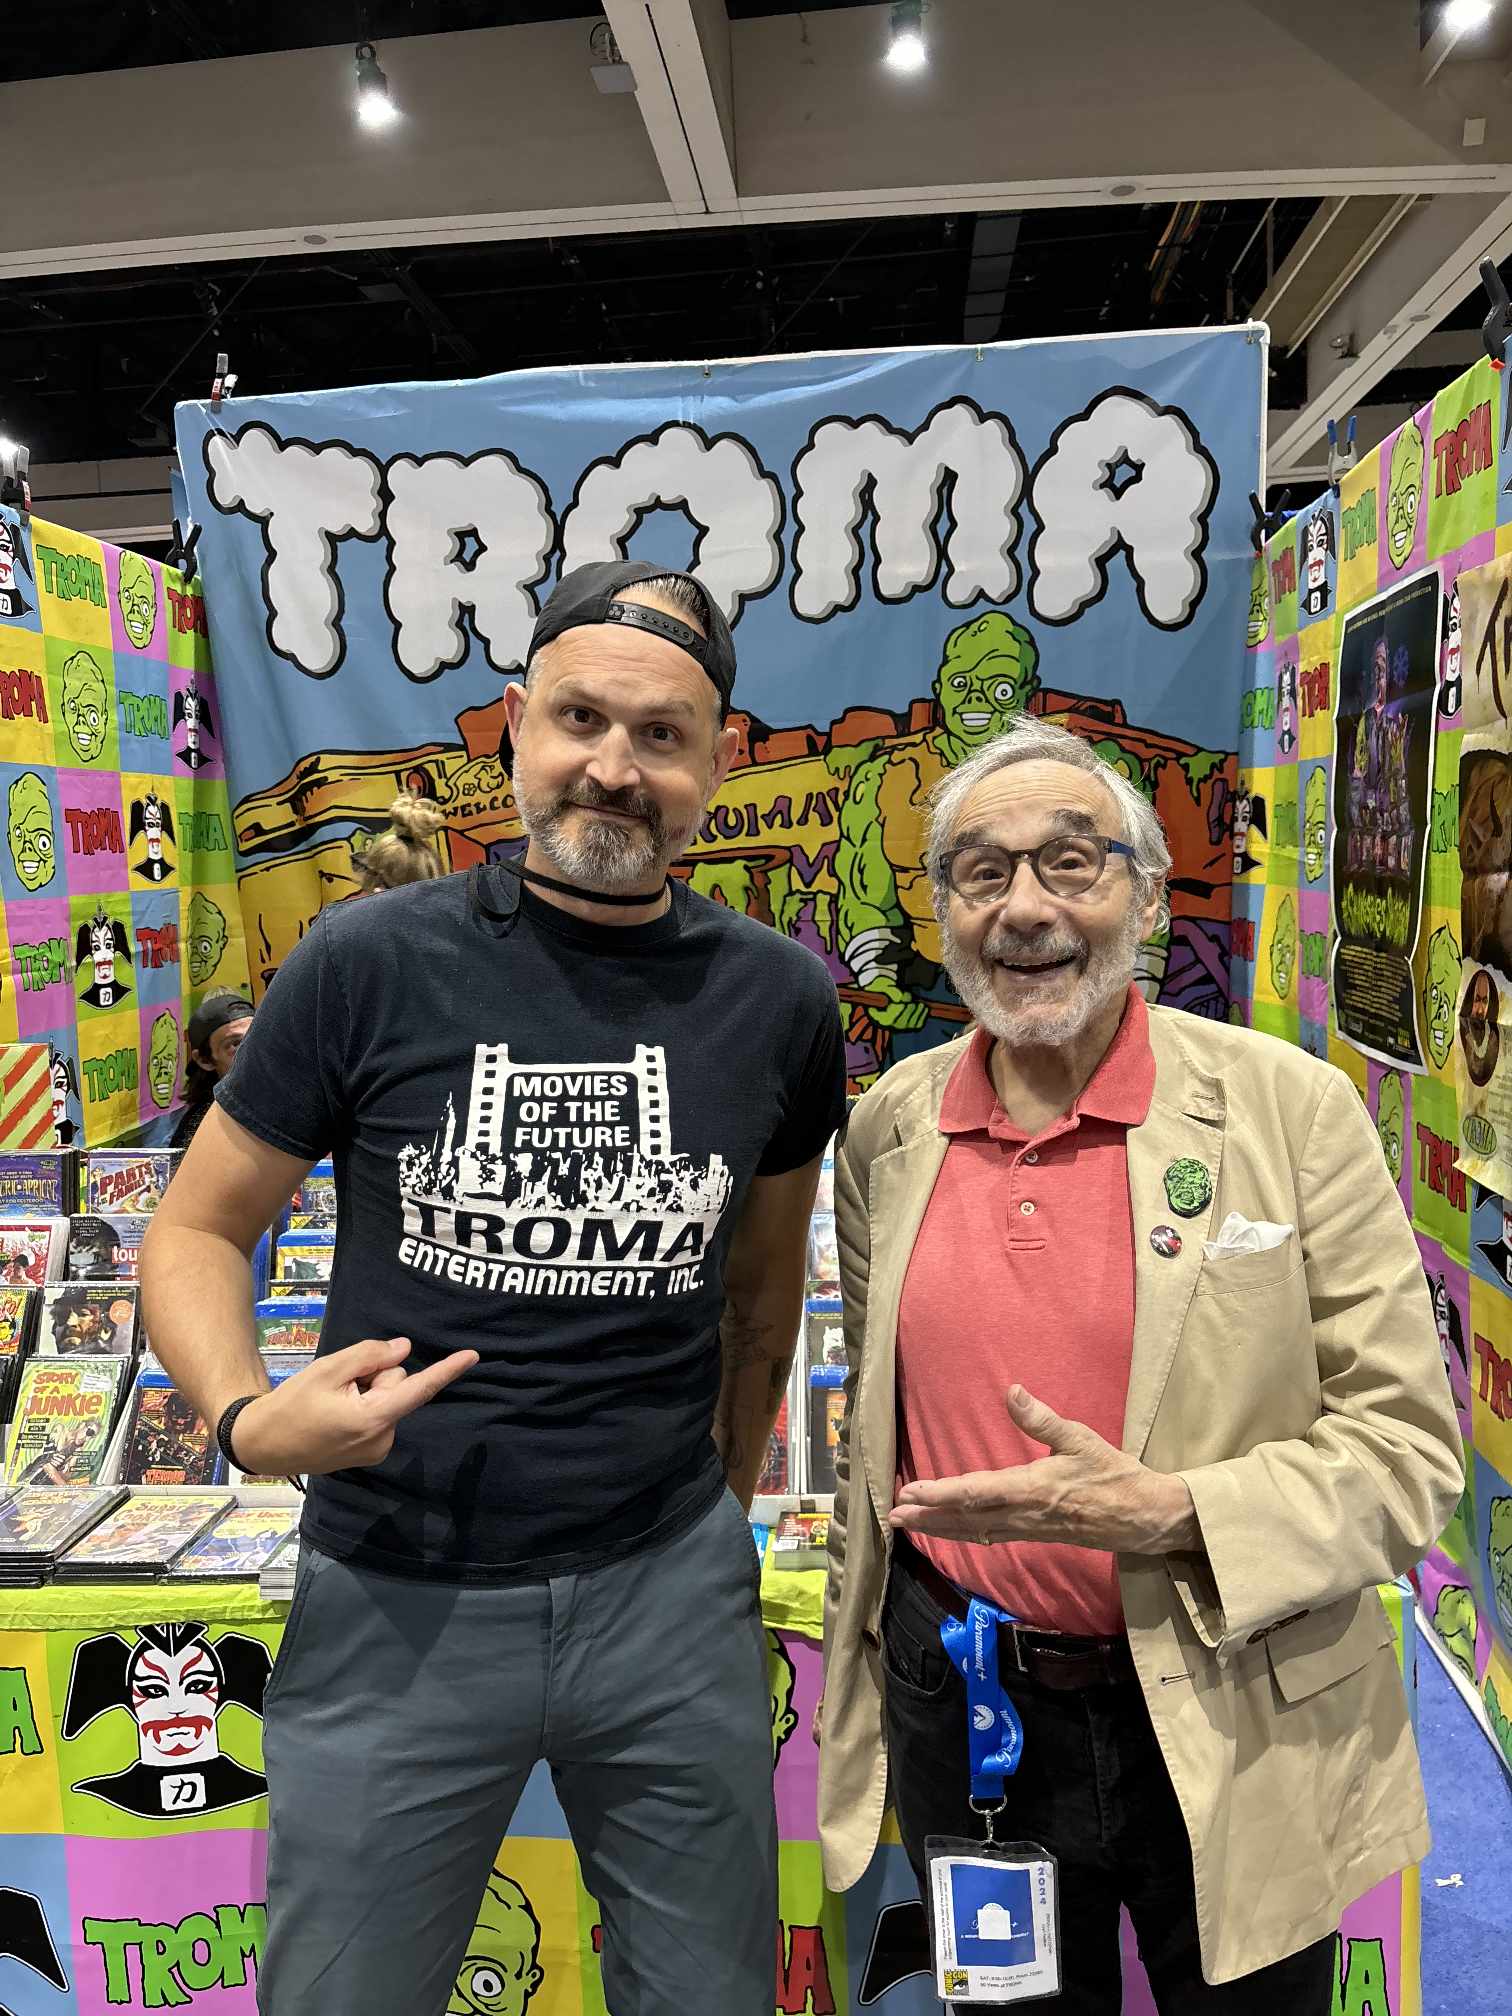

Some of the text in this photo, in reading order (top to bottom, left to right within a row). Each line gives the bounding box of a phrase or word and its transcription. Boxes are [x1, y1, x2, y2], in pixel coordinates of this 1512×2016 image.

[1434, 399, 1494, 500] TROMA
[203, 384, 1221, 684] TROMA
[36, 543, 108, 609] TROMA
[118, 690, 170, 740] TROMA
[64, 807, 126, 856] TROMA
[83, 1047, 139, 1104] TROMA
[513, 1074, 628, 1098] MOVIES
[519, 1100, 621, 1123] OF THE
[514, 1125, 632, 1149] FUTURE
[99, 1159, 153, 1196] PARTS
[401, 1200, 705, 1263] TROMA
[33, 1371, 79, 1385] STORY
[33, 1385, 60, 1395] OF A
